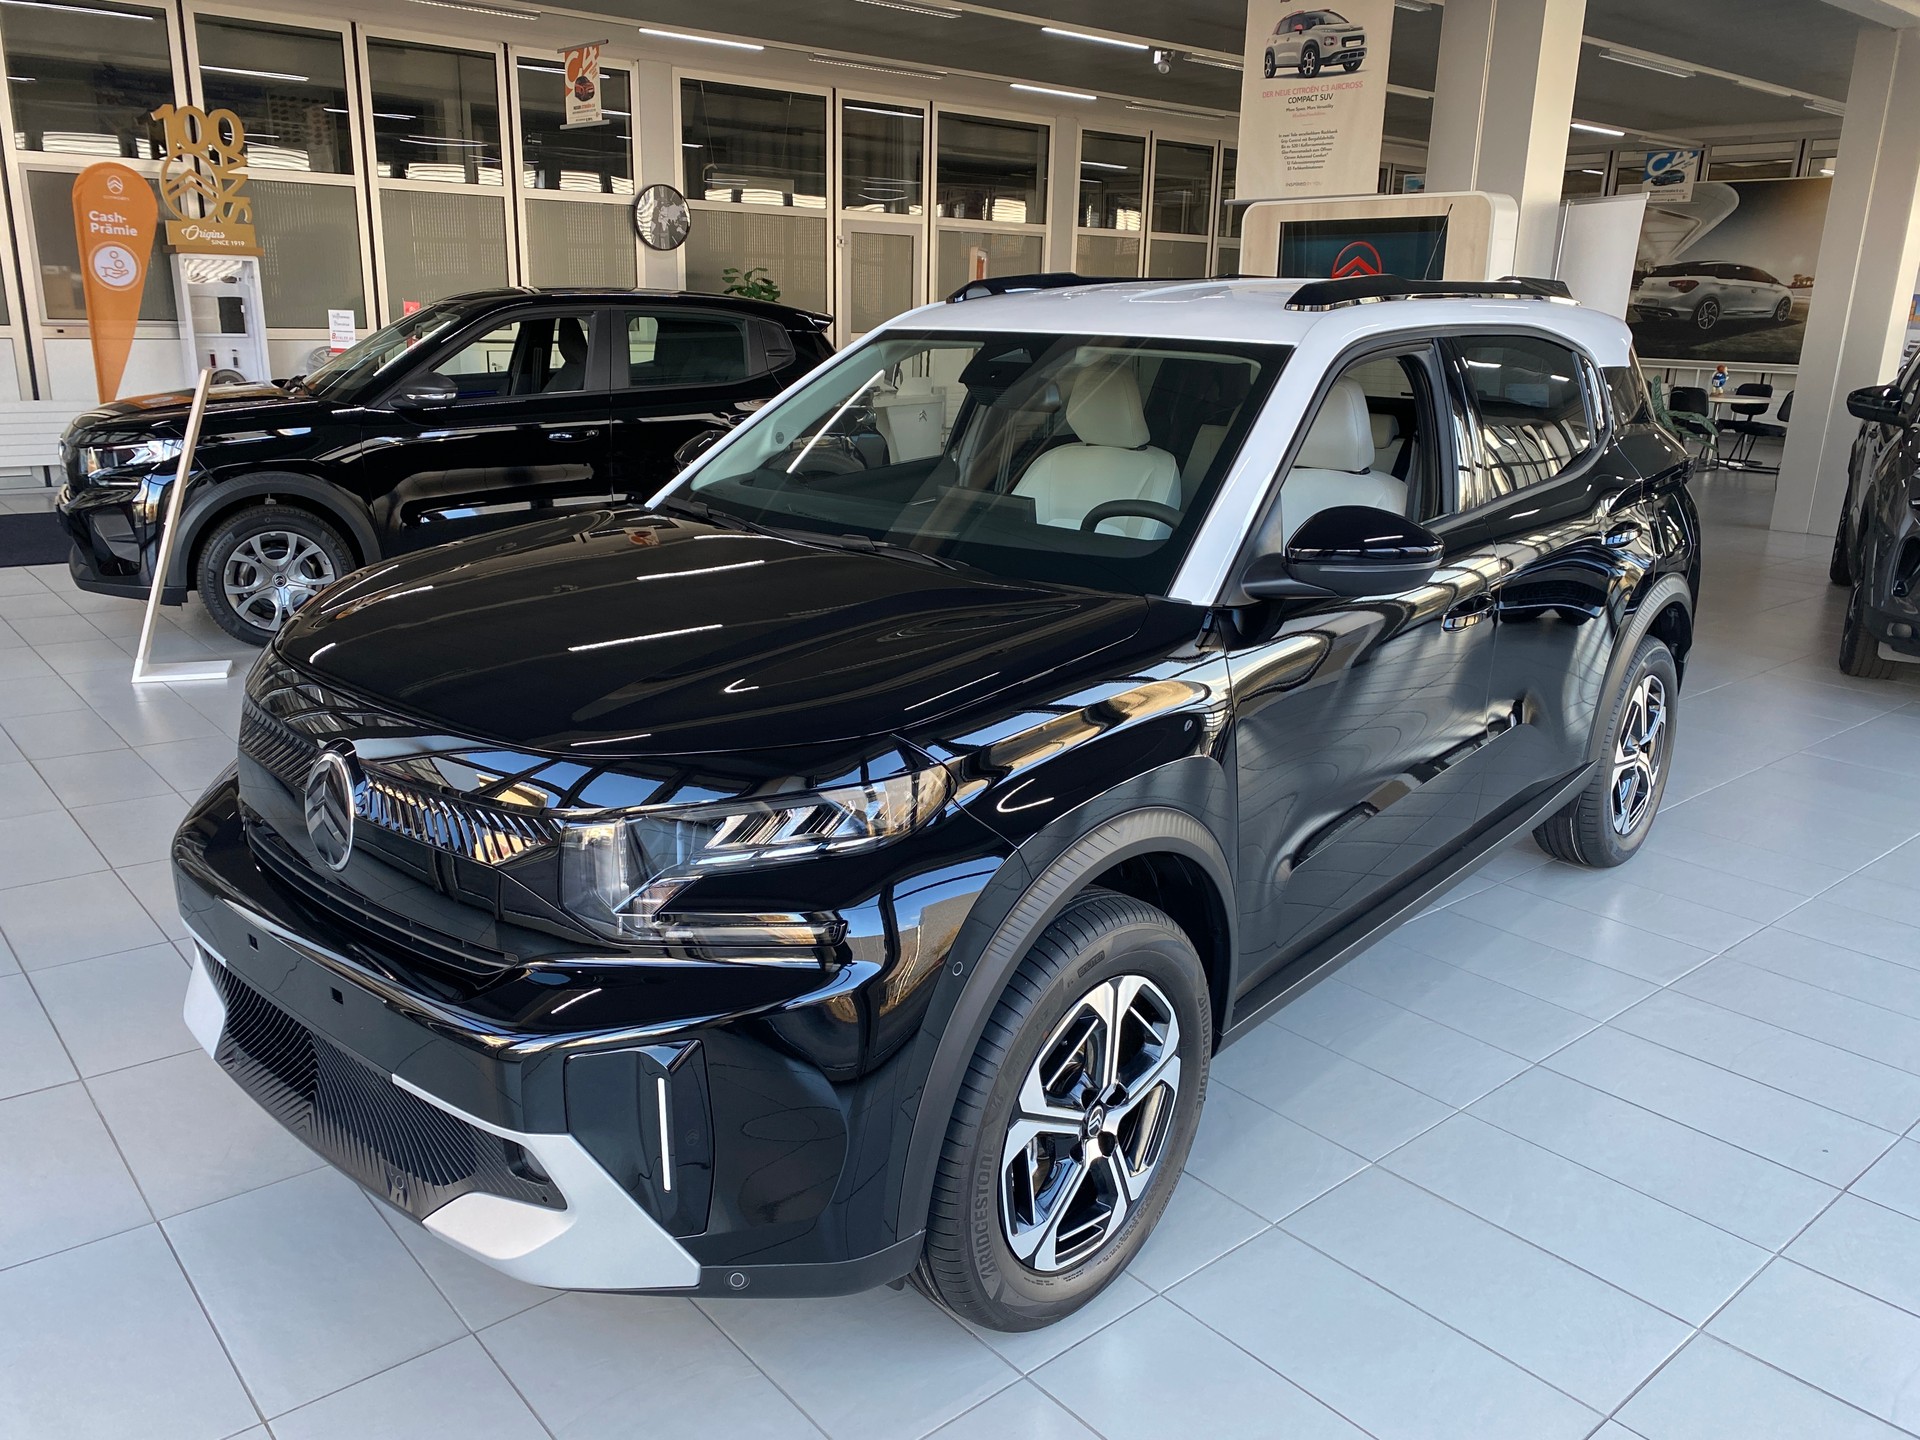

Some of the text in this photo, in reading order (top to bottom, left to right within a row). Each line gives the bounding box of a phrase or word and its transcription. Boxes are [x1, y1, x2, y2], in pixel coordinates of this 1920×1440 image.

[1262, 89, 1274, 98] DER
[1275, 88, 1292, 97] NEUE
[1292, 86, 1320, 95] CITROËN
[1331, 80, 1364, 90] AIRCROSS
[1288, 94, 1318, 104] COMPACT
[150, 104, 244, 156] 100
[88, 210, 127, 224] Cash-
[90, 222, 138, 236] Prämie
[181, 224, 226, 240] Origins
[974, 1142, 998, 1280] BRIDGESTONE
